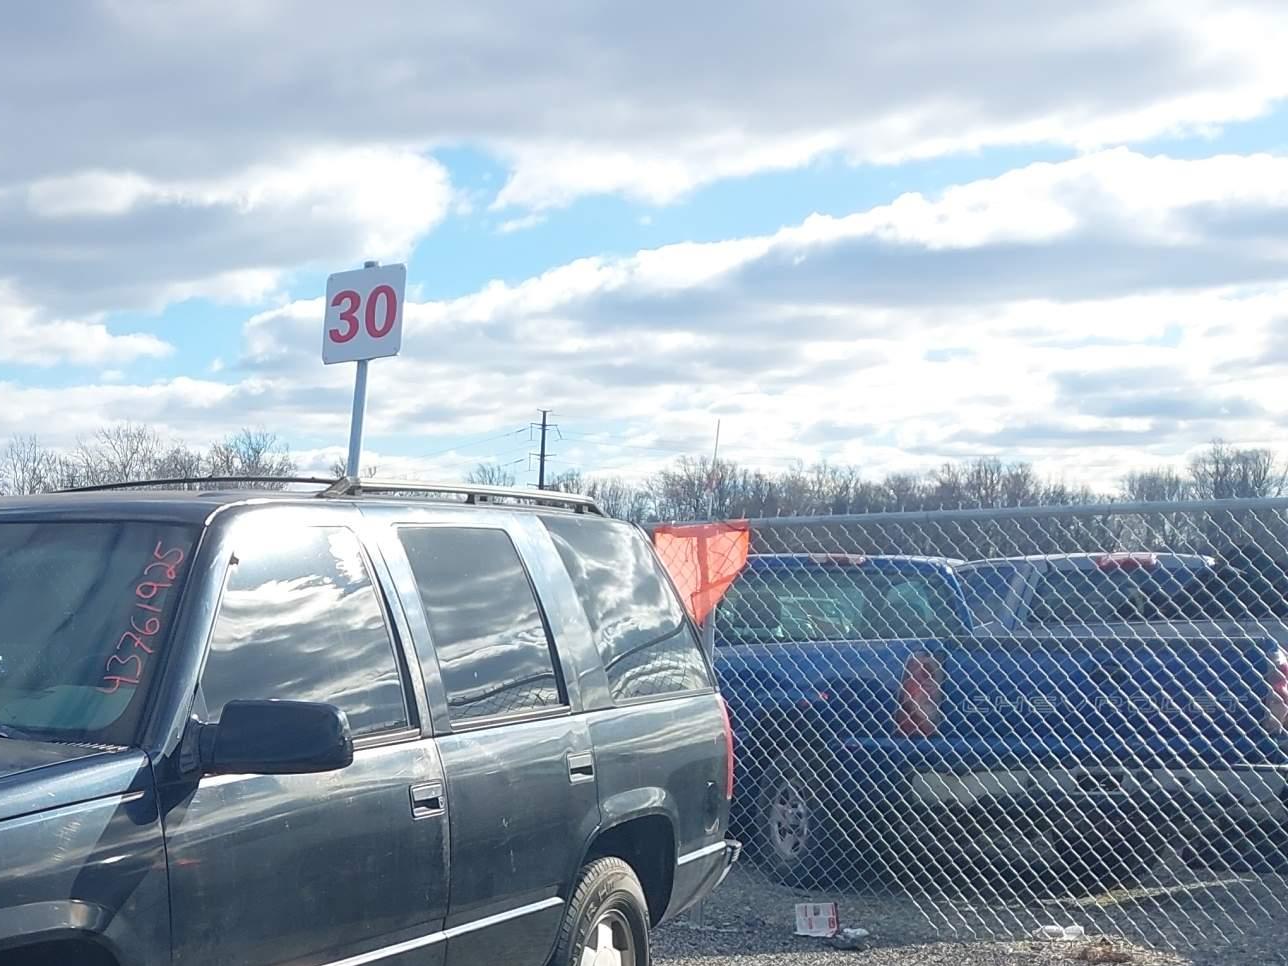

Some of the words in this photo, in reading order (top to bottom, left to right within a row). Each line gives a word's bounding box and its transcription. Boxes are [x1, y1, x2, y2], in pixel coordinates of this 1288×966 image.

[329, 284, 398, 344] 30
[96, 541, 185, 695] 43761925
[961, 695, 1249, 714] CHEVROLET
